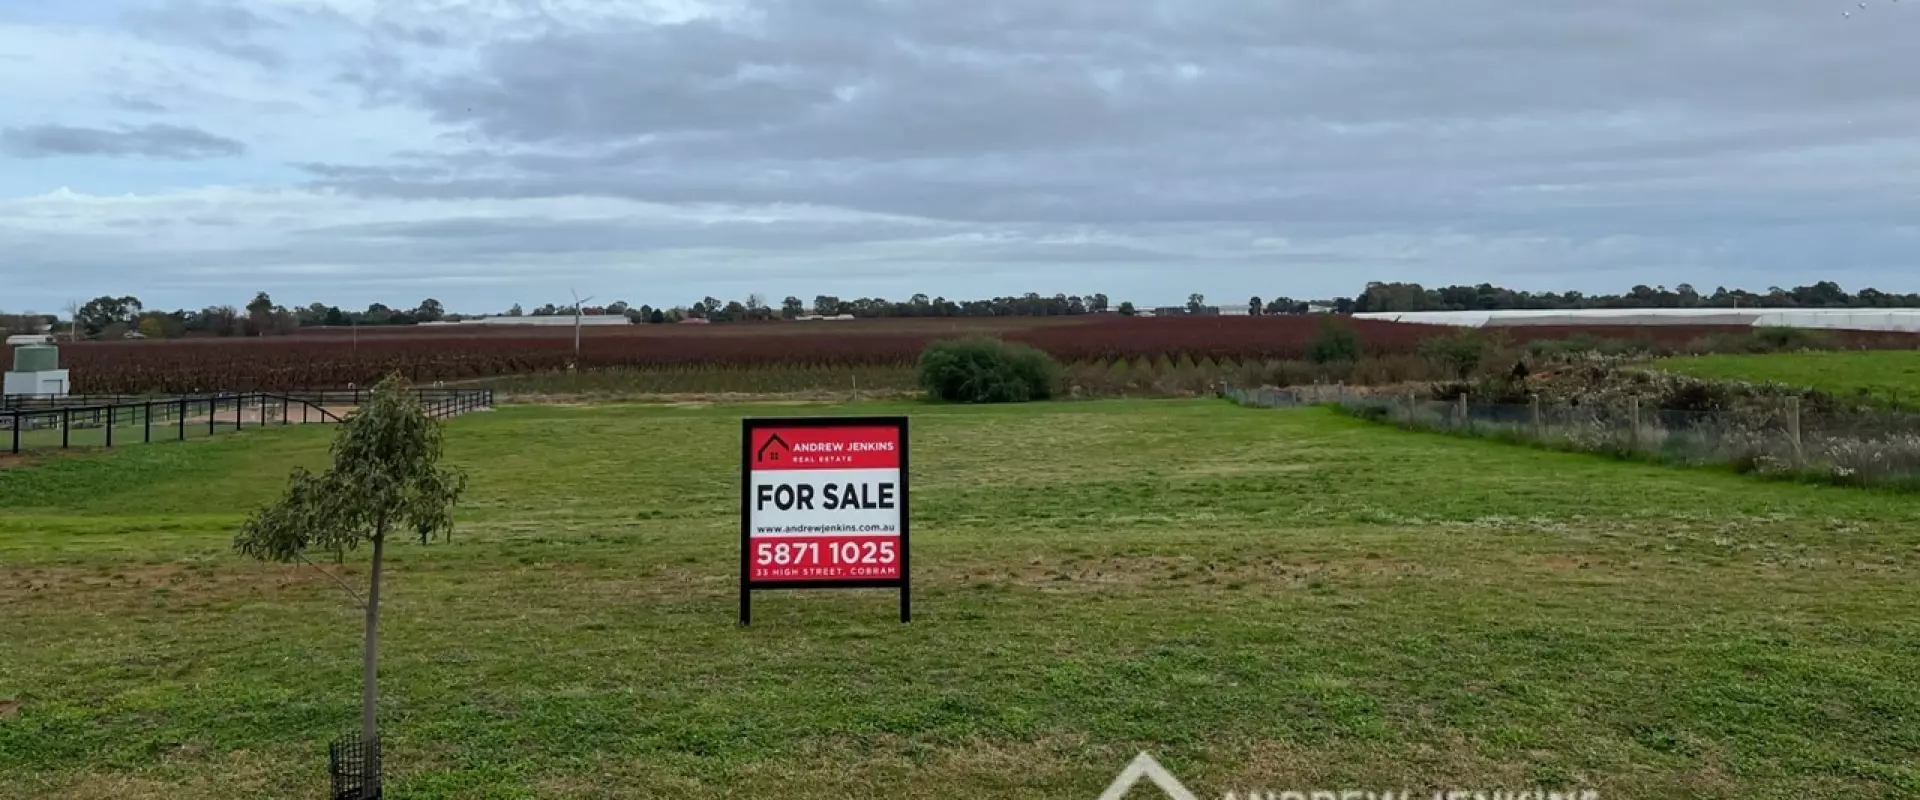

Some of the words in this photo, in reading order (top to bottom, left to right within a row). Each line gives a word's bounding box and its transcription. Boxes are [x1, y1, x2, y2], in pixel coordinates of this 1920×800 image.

[793, 443, 843, 452] ANDREW
[847, 442, 894, 451] JENKINS
[757, 484, 814, 511] FOR
[823, 482, 895, 510] SALE
[757, 523, 895, 533] www.andrewjenkins.com.au
[757, 542, 820, 565] 5871
[829, 541, 895, 564] 1025
[773, 568, 798, 576] HIGH
[851, 567, 896, 575] COBRAM
